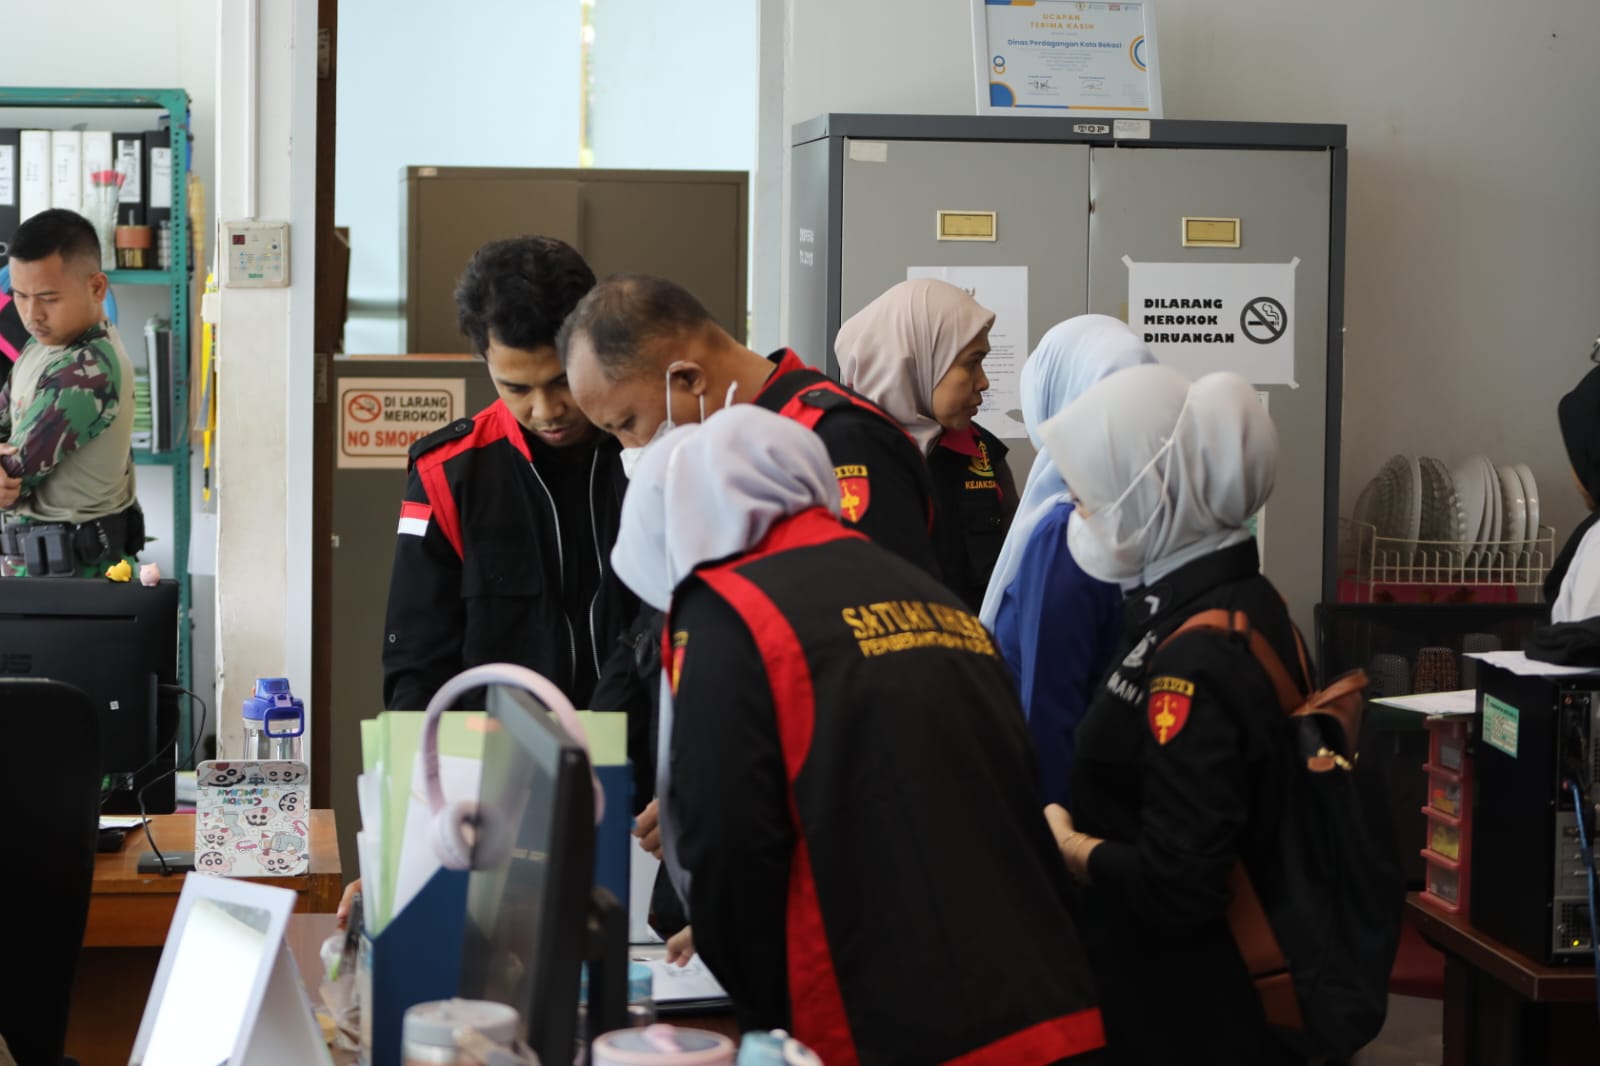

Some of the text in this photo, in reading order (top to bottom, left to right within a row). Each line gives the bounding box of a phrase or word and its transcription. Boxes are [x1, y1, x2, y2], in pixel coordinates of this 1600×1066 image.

[1029, 40, 1079, 48] Perdagangan
[1077, 125, 1105, 133] TOP
[1144, 298, 1223, 309] DILARANG
[1144, 315, 1218, 325] MEROKOK
[1144, 333, 1235, 343] DIRUANGAN
[384, 396, 448, 408] DI LARANG
[384, 410, 448, 422] MEROKOK
[347, 430, 431, 447] NO SMOK
